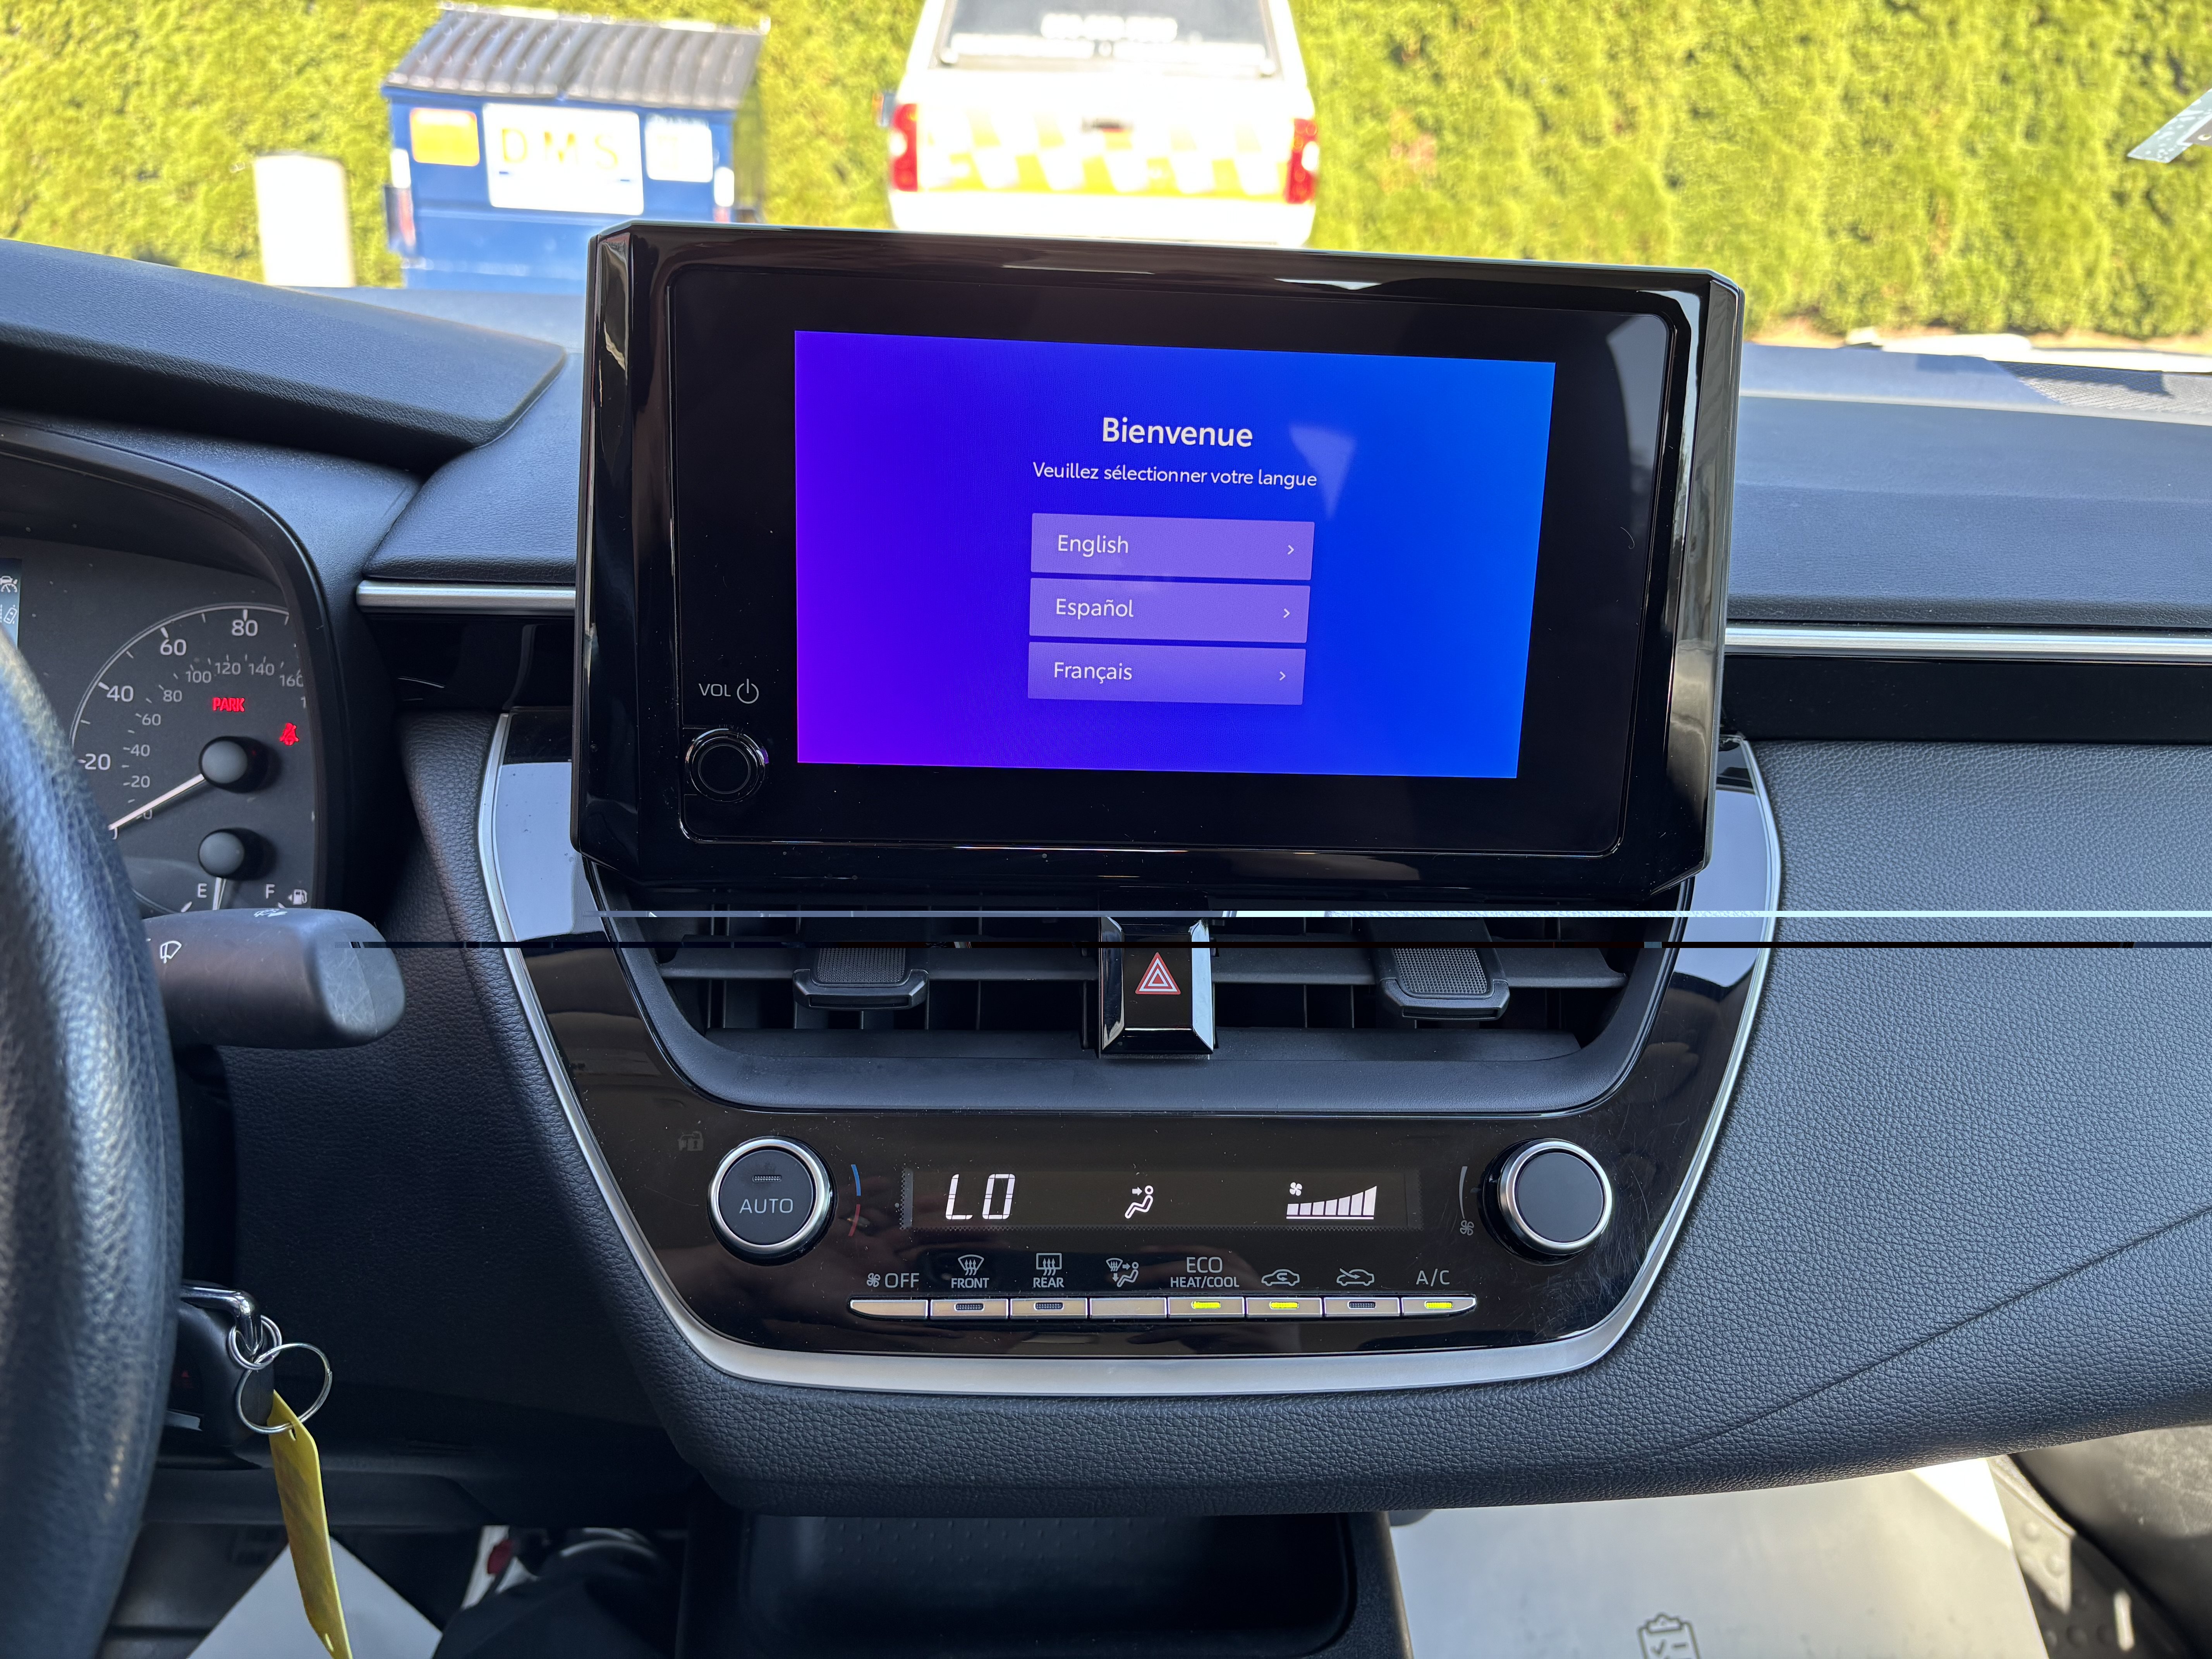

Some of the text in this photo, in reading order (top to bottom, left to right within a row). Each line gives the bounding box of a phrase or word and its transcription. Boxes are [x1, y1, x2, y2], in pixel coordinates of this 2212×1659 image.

[1102, 417, 1253, 447] Bienvenue
[1033, 462, 1317, 489] Veuillez sélectionner votre langue
[1057, 534, 1129, 558] English
[1055, 598, 1134, 620] Español
[232, 620, 258, 636] 80
[160, 639, 187, 656] 60
[215, 662, 241, 675] 120
[249, 663, 275, 676] 140
[1054, 662, 1133, 684] Français
[185, 670, 211, 683] 100
[107, 685, 134, 702] 40
[163, 690, 182, 702] 80
[698, 683, 731, 697] VOL
[212, 698, 245, 712] PARK
[142, 714, 161, 726] 60
[130, 744, 151, 756] 40
[84, 754, 111, 771] 20
[131, 776, 151, 788] 20
[198, 883, 207, 898] E
[266, 884, 275, 899] F
[946, 1174, 1015, 1220] LO
[739, 1199, 793, 1214] AUTO
[1186, 1257, 1223, 1274] ECO
[884, 1273, 920, 1288] OFF
[951, 1278, 989, 1288] FRONT
[1033, 1277, 1064, 1288] REAR
[1170, 1277, 1239, 1288] HEAT/COOL
[1416, 1270, 1450, 1286] A/C
